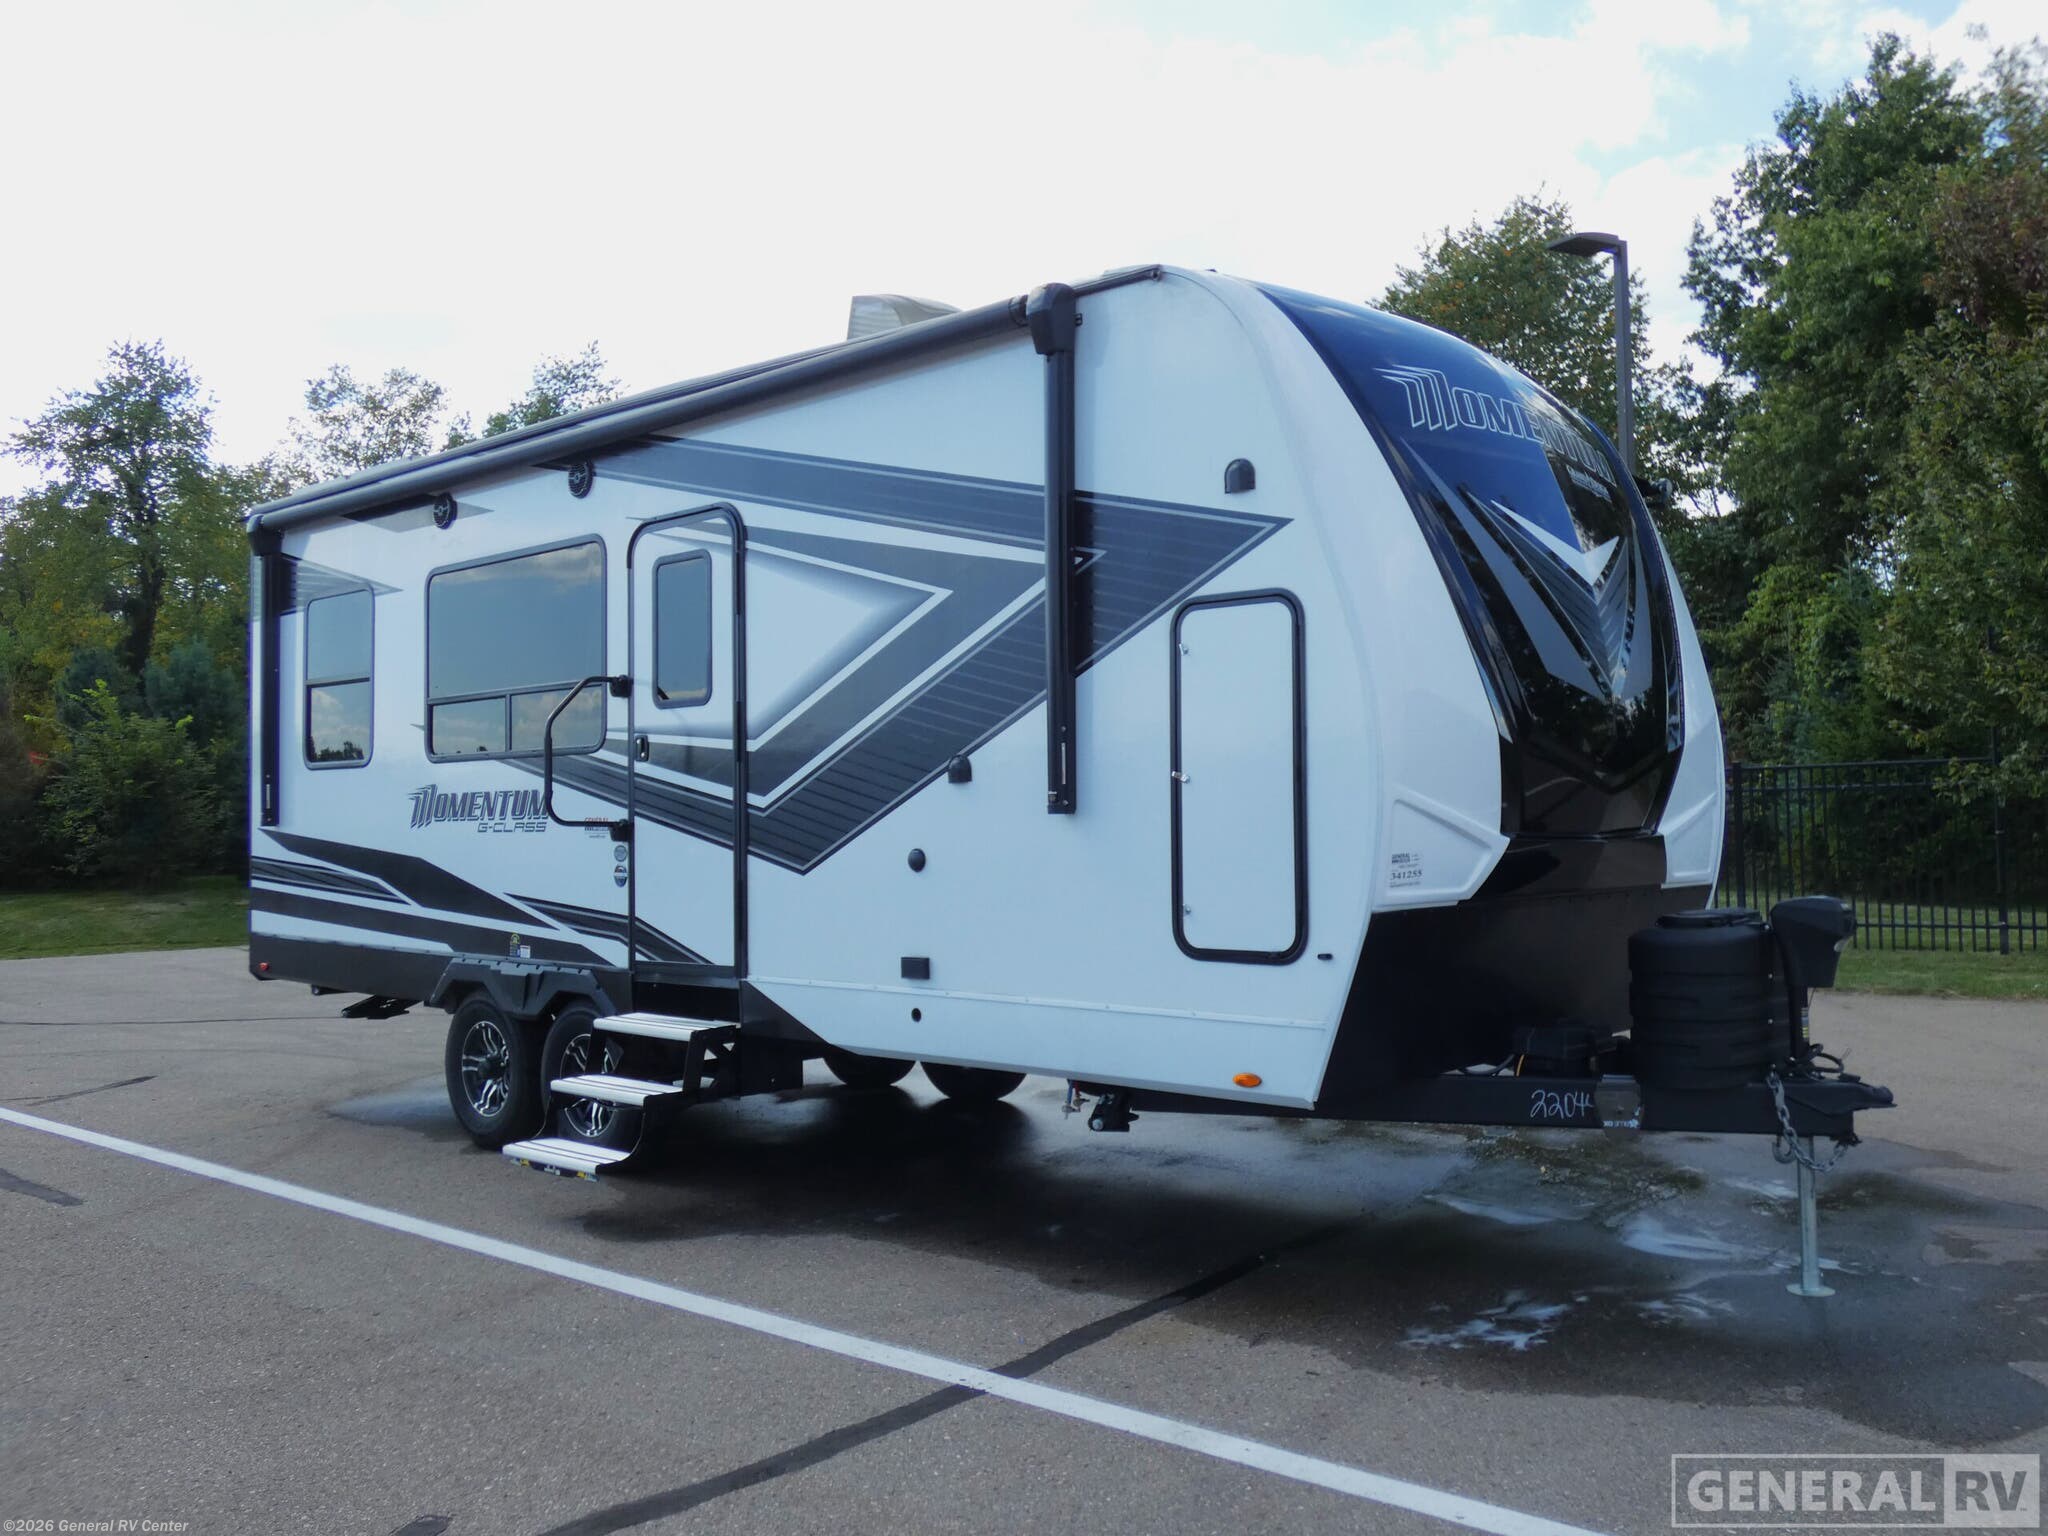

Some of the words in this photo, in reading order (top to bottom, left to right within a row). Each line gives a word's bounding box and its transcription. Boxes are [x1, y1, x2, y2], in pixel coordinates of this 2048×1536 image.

[1373, 364, 1617, 488] MOMENTUM
[408, 784, 549, 829] MOMENTUM
[477, 822, 547, 833] G-CLASS
[1530, 1089, 1594, 1119] 2204
